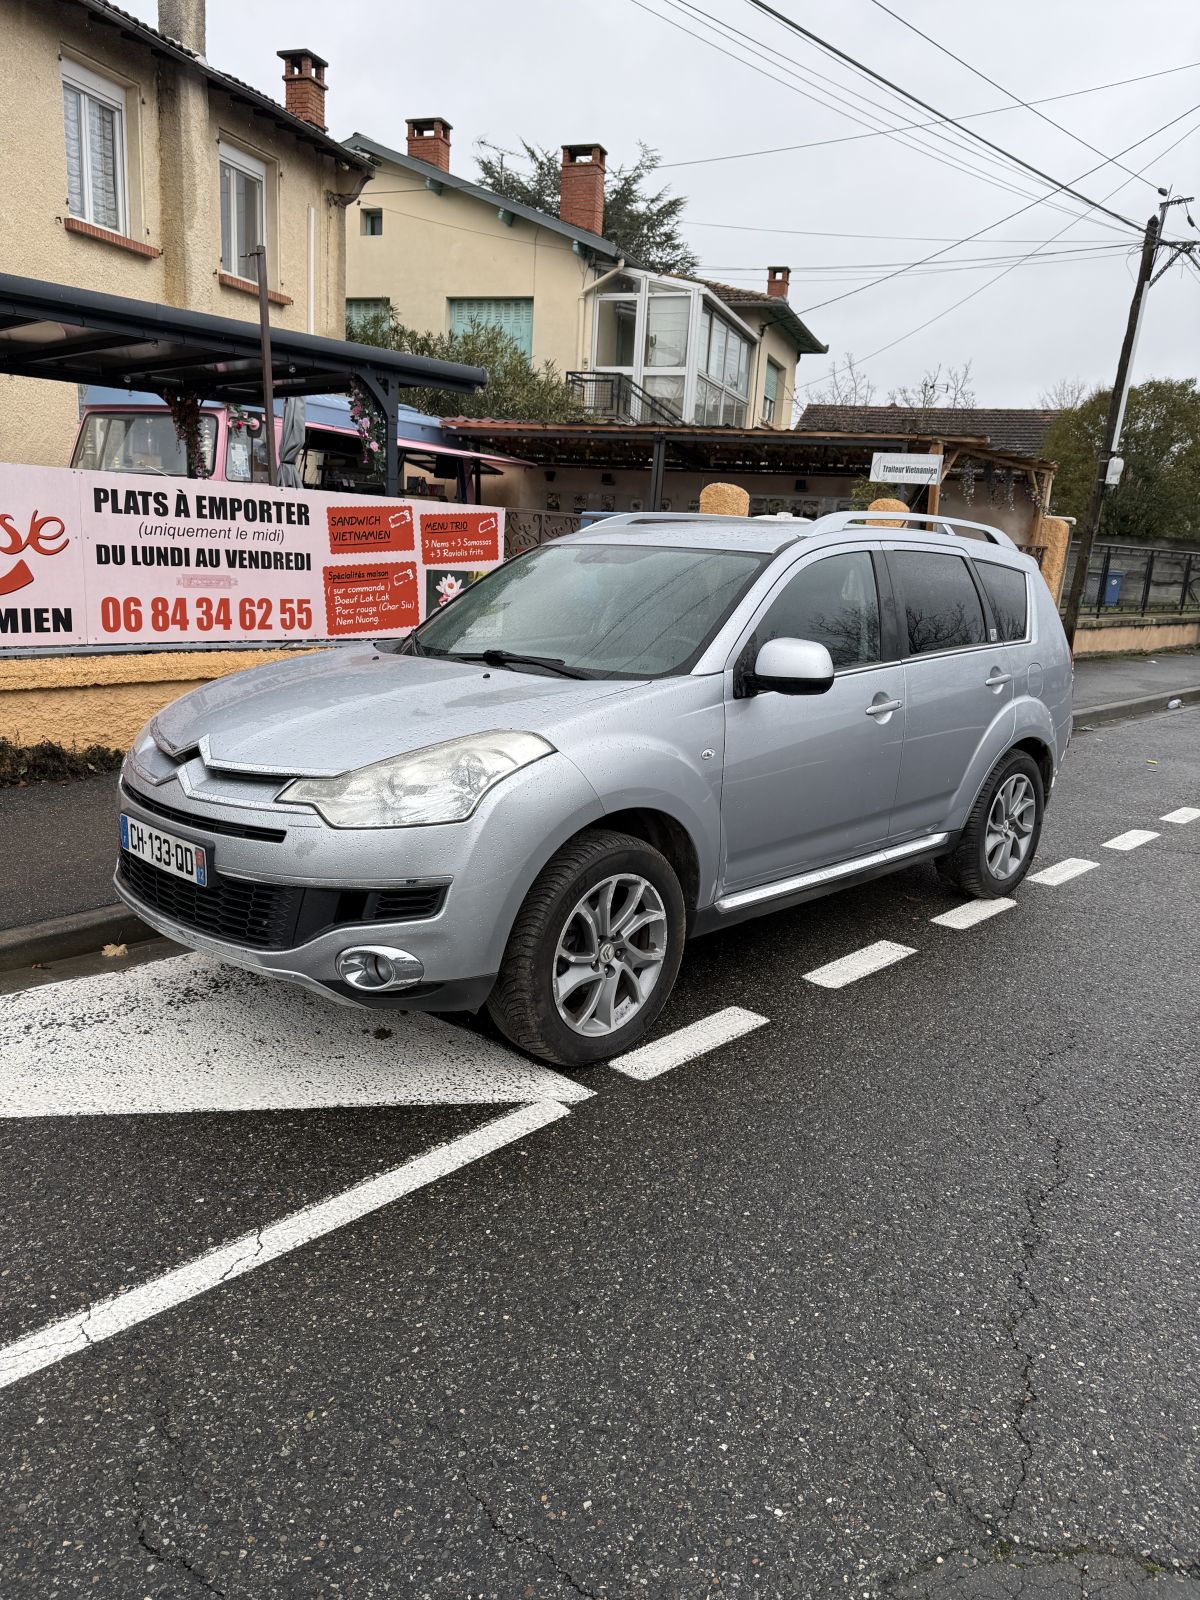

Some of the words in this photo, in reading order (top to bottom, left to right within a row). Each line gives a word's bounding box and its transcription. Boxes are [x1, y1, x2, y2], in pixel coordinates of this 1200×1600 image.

[883, 465, 905, 473] Traiteur
[93, 487, 169, 517] PLATS
[174, 488, 191, 518] À
[196, 494, 310, 526] EMPORTER
[331, 515, 381, 526] SANDWICH
[424, 521, 449, 532] MENU
[450, 521, 468, 530] TRIO
[138, 521, 232, 540] (uniquement
[235, 527, 248, 540] le
[252, 528, 285, 545] midi)
[332, 530, 391, 542] VIETNAMIEN
[424, 539, 430, 549] 3
[430, 539, 449, 548] Nems
[457, 538, 462, 547] 3
[96, 544, 126, 566] DU
[131, 545, 191, 567] LUNDI
[195, 547, 221, 568] AU
[224, 549, 312, 571] VENDREDI
[436, 549, 441, 558] 3
[442, 548, 468, 558] Raviolis
[469, 547, 484, 556] frits
[335, 595, 358, 605] Boeuf
[359, 594, 374, 603] Lok
[336, 606, 354, 615] Porc
[356, 606, 377, 616] rouge
[378, 602, 400, 613] (Char
[400, 600, 415, 610] Siu)
[101, 597, 143, 633] 06
[151, 597, 190, 632] 84
[195, 597, 232, 631] 34
[239, 597, 273, 631] 62
[279, 598, 313, 631] 55
[336, 617, 354, 626] Nem
[130, 823, 194, 876] CH-133-QD
